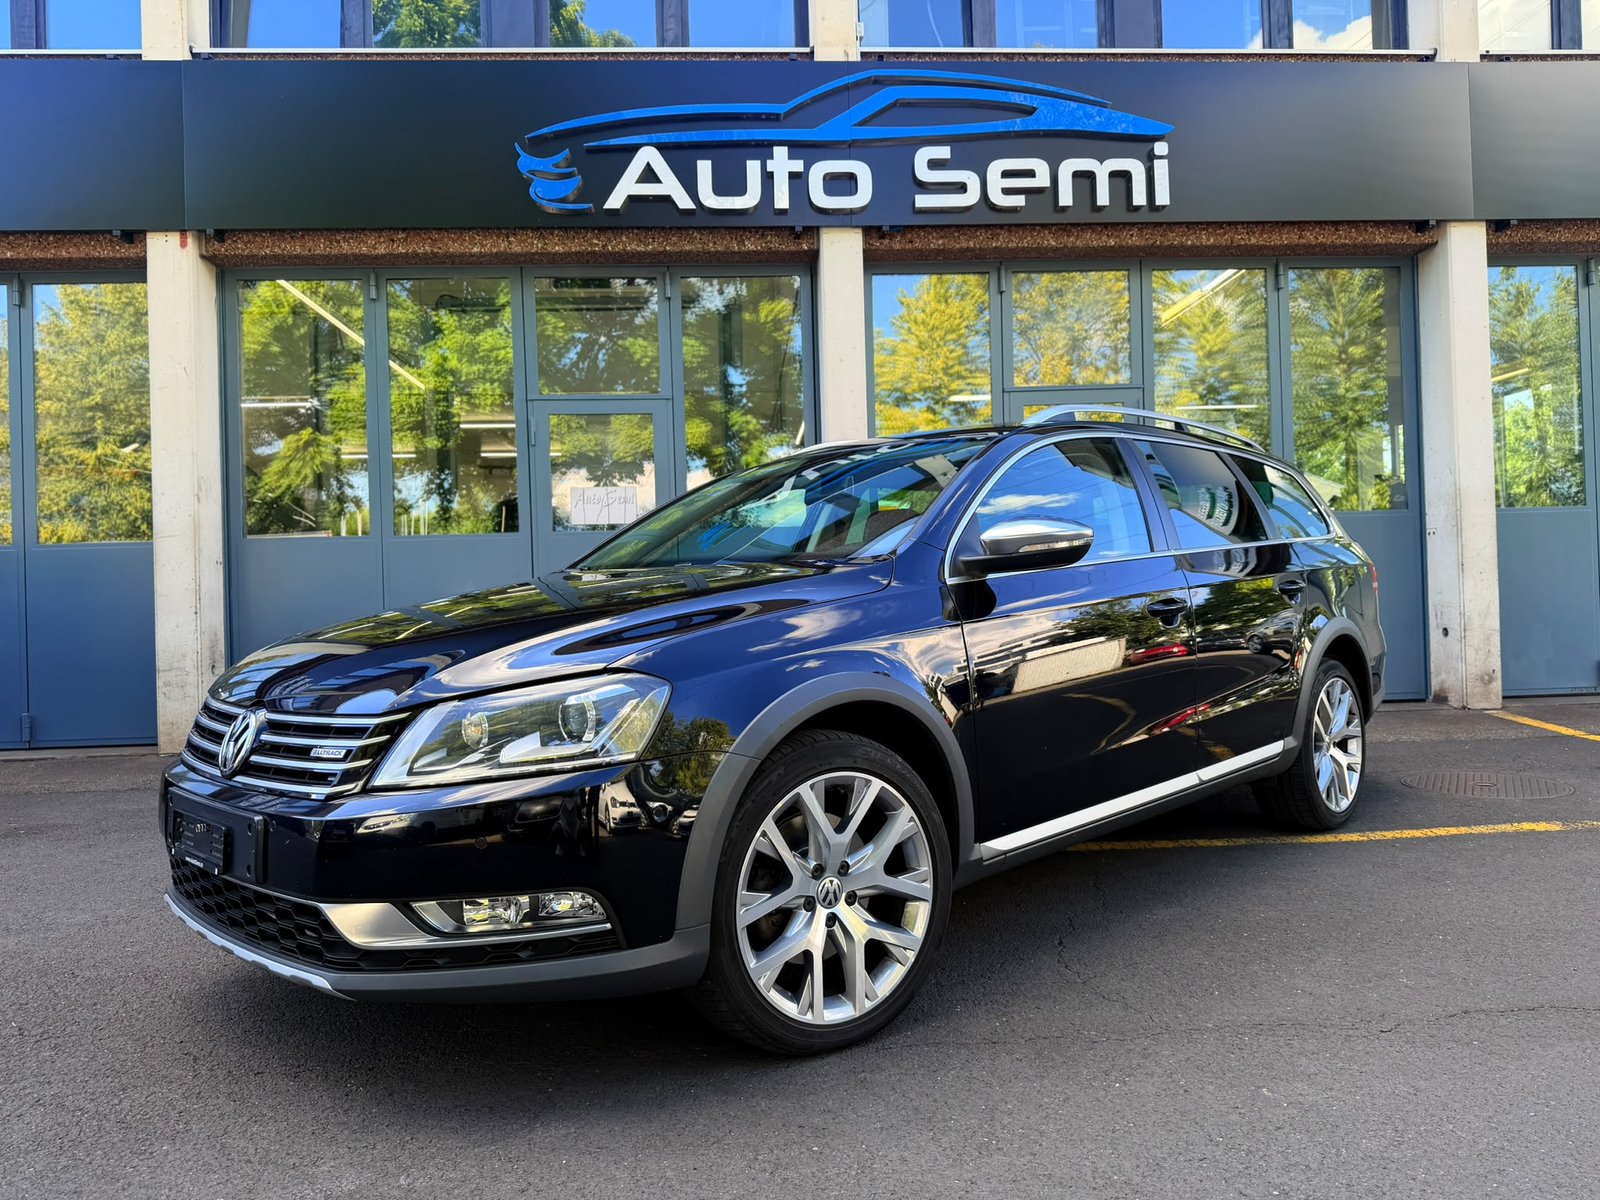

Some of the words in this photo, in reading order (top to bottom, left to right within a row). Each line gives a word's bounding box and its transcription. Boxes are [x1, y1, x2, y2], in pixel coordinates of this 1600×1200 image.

[602, 145, 873, 211] Auto
[913, 141, 1171, 209] Semi
[312, 748, 344, 757] ALLTRACK
